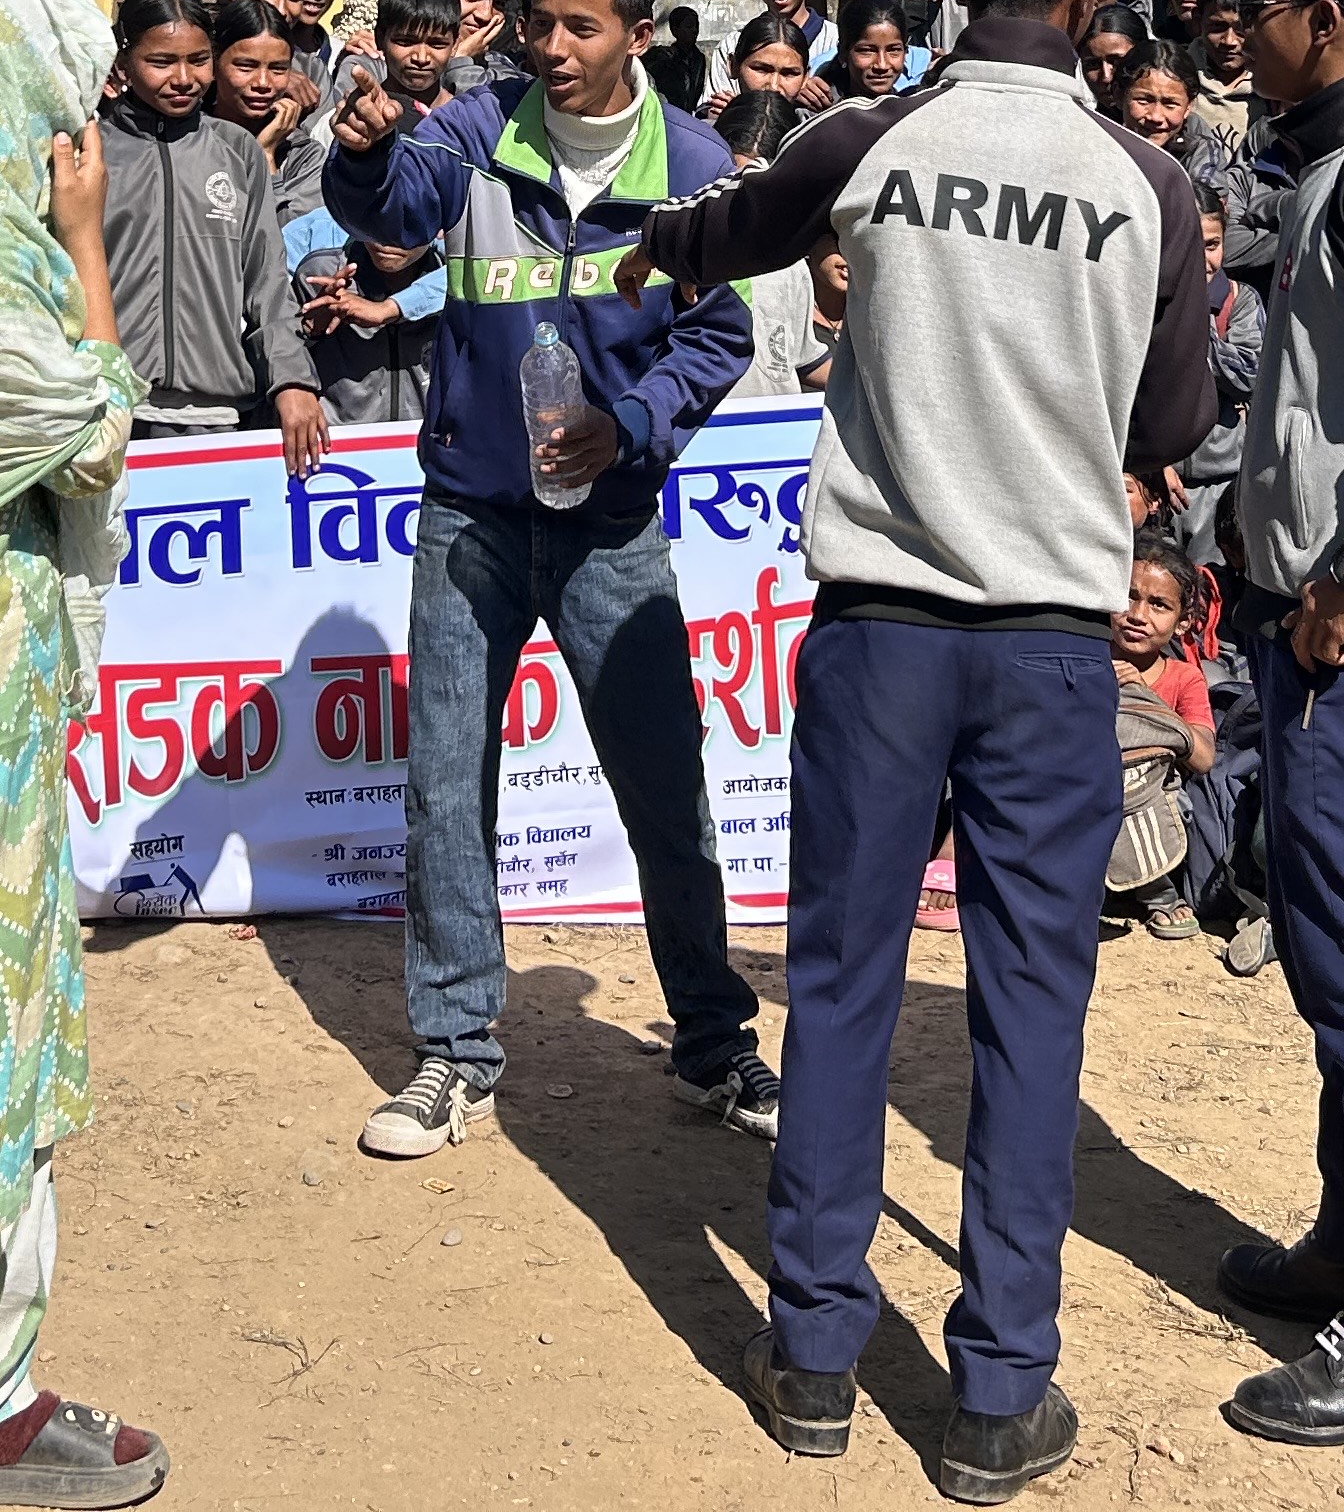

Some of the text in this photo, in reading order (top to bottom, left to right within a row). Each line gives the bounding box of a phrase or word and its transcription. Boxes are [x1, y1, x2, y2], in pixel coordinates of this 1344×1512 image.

[870, 169, 1131, 263] ARMY
[720, 818, 756, 834] बाल
[130, 834, 185, 860] सहयोग
[324, 843, 346, 861] श्री
[526, 824, 592, 845] विद्यालय
[535, 879, 568, 897] समूह
